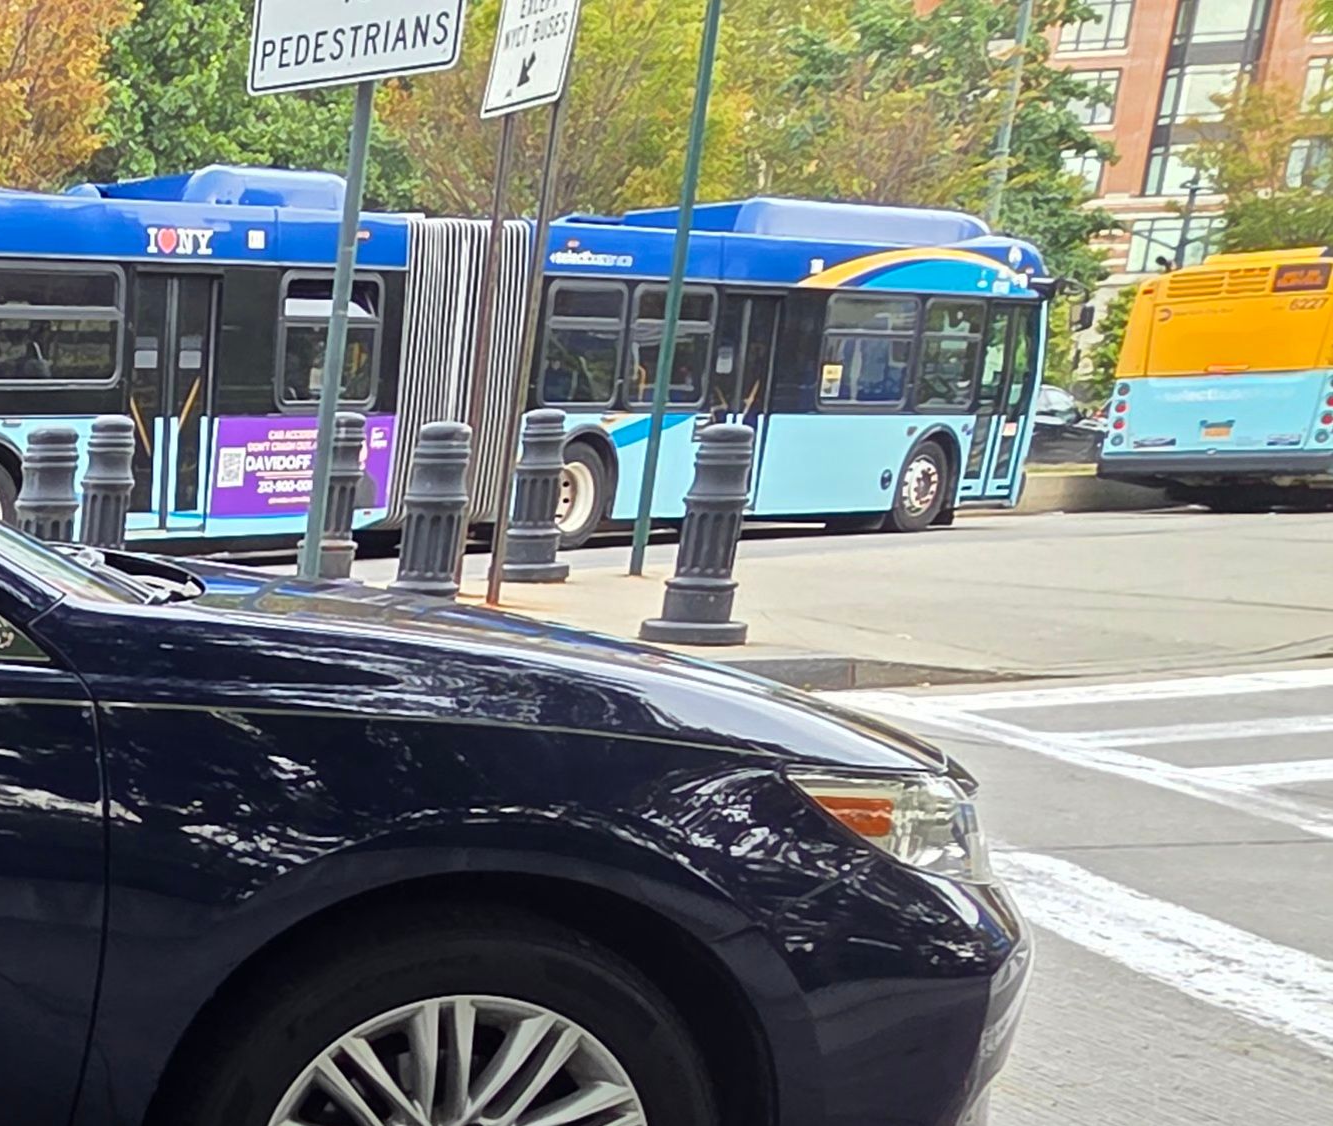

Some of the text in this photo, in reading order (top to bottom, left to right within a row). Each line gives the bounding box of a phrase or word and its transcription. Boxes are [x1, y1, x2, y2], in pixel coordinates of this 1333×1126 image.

[533, 11, 569, 42] BUSES
[260, 11, 450, 72] PEDESTRIANS
[176, 228, 213, 255] NY
[246, 455, 312, 471] DAVIDOFF
